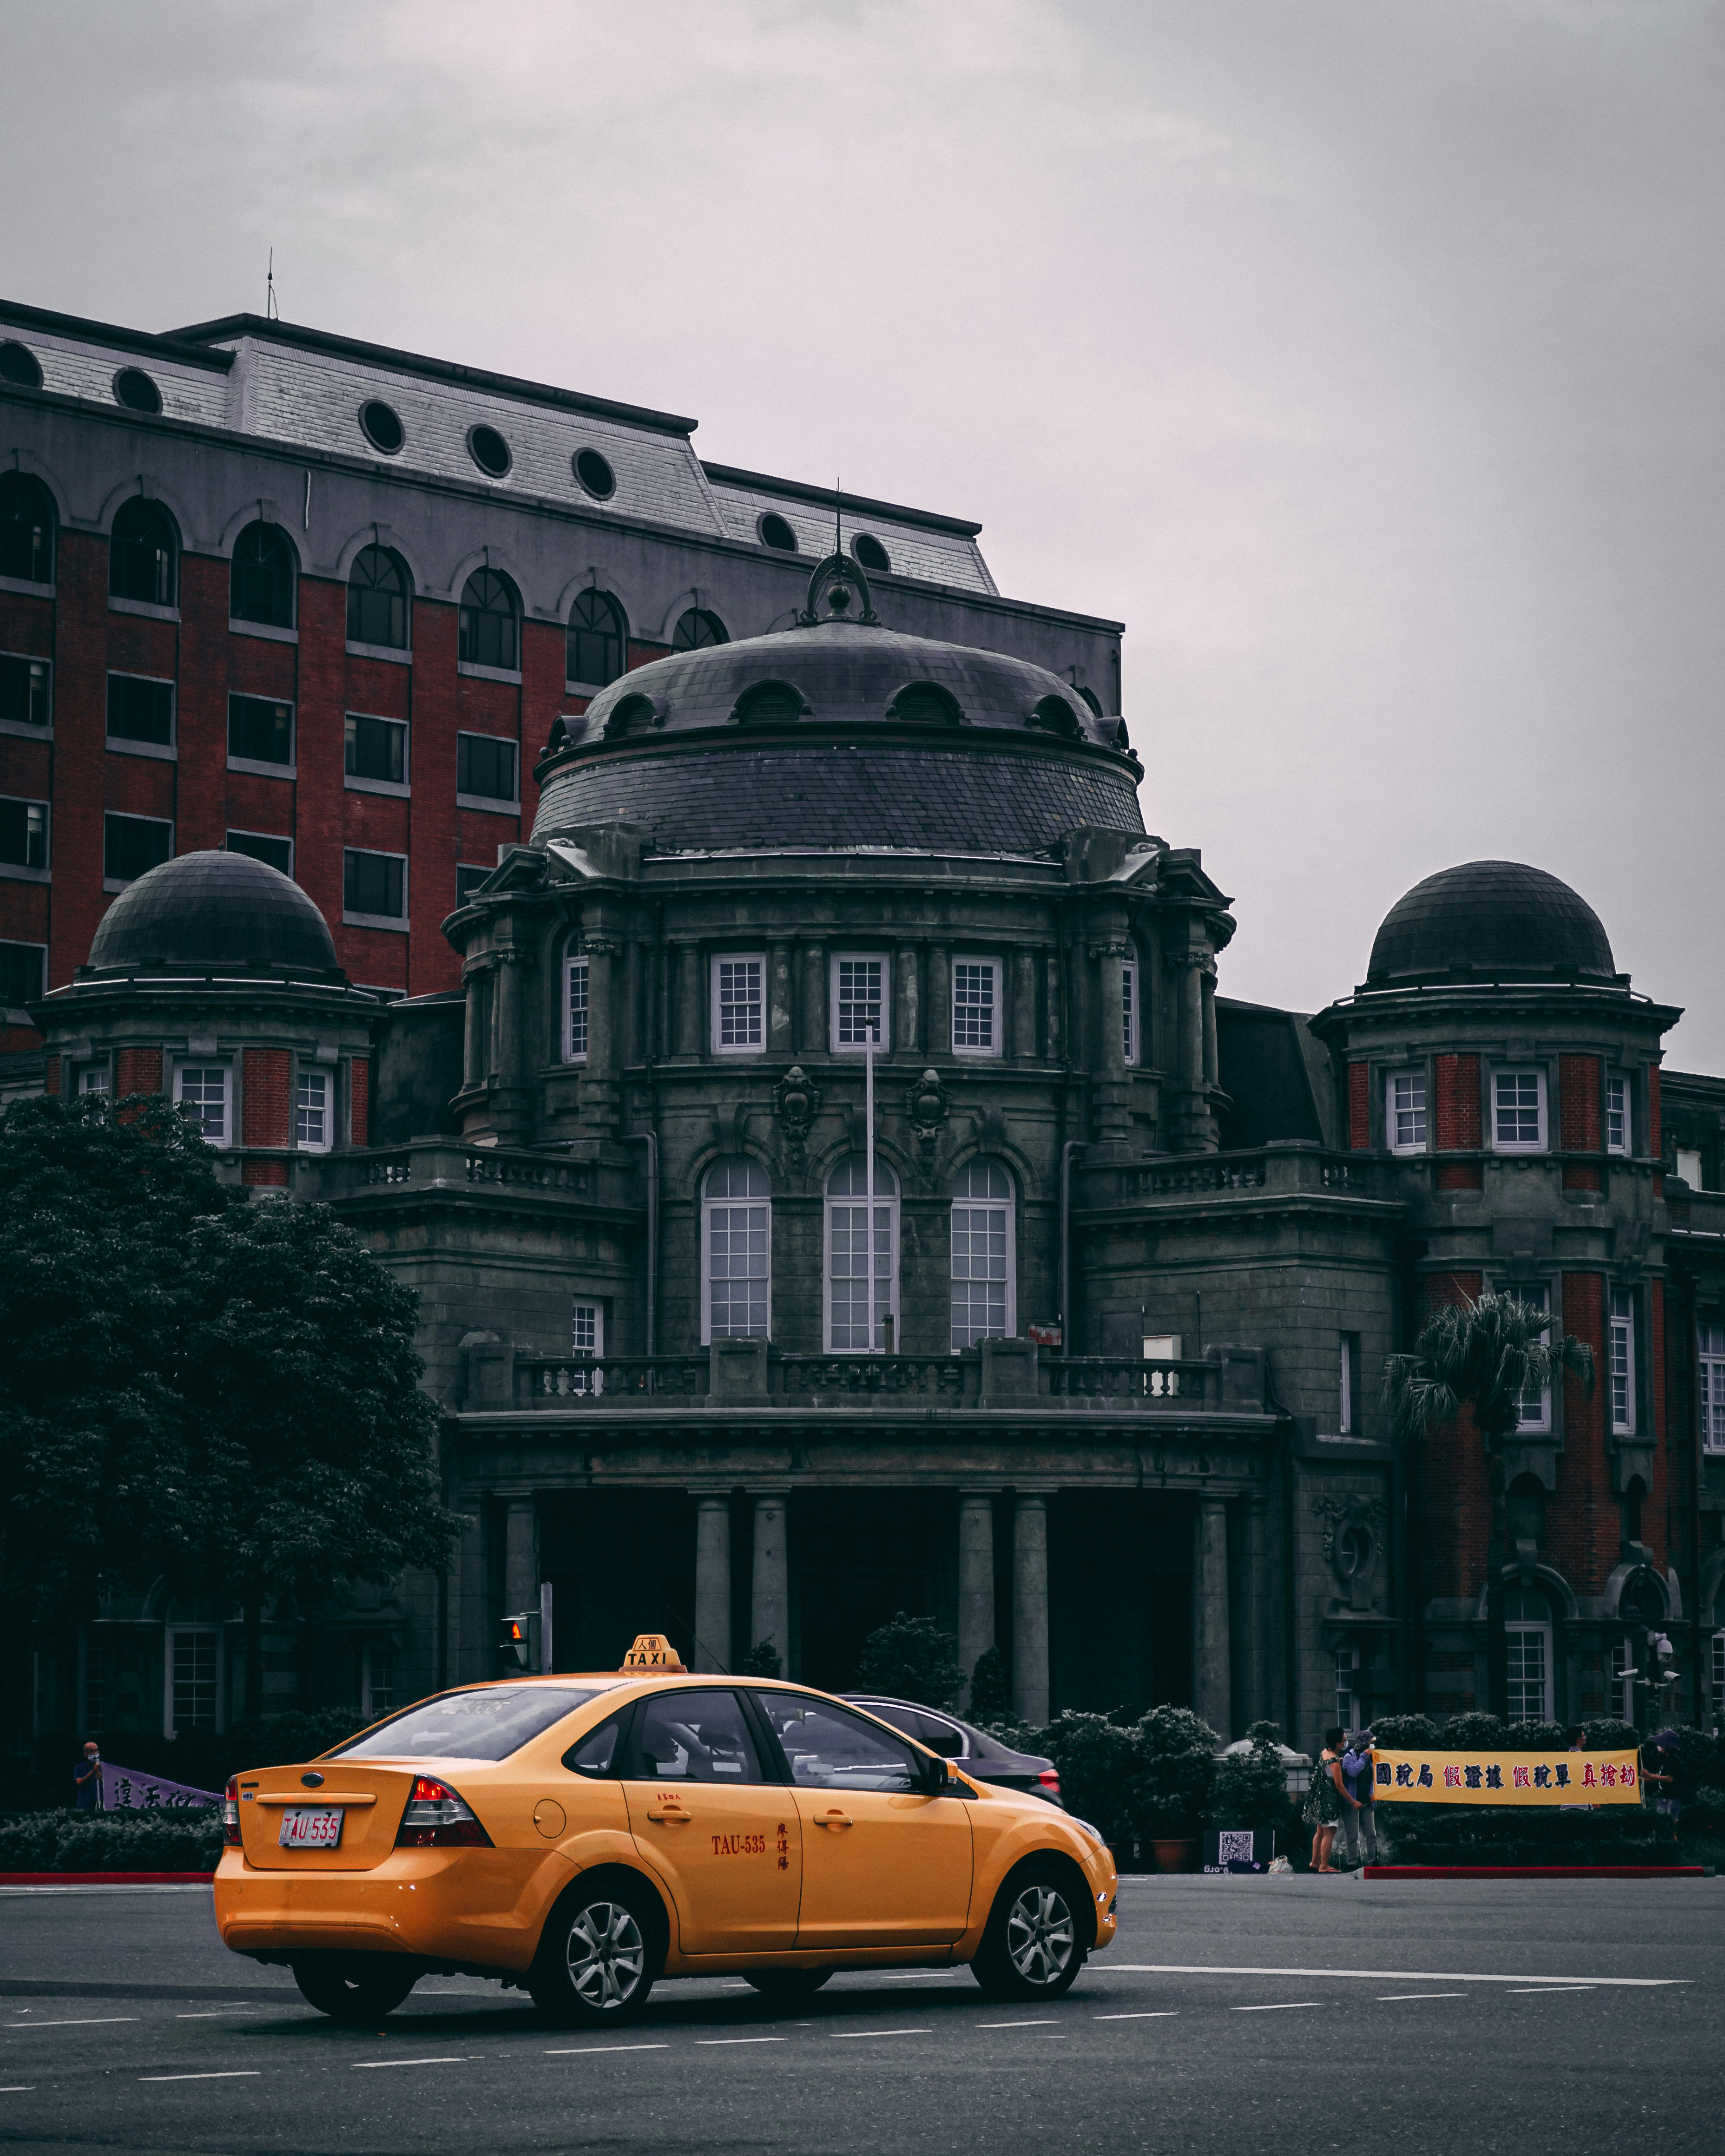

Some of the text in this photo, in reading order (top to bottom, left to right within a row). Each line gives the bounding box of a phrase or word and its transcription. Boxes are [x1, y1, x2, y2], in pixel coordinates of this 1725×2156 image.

[628, 1652, 666, 1665] TAXI
[1376, 1762, 1635, 1789] 國稅局 假證據 假稅單 真搶劫
[712, 1835, 766, 1854] TAU-535
[777, 1823, 790, 1871] 廖得陽
